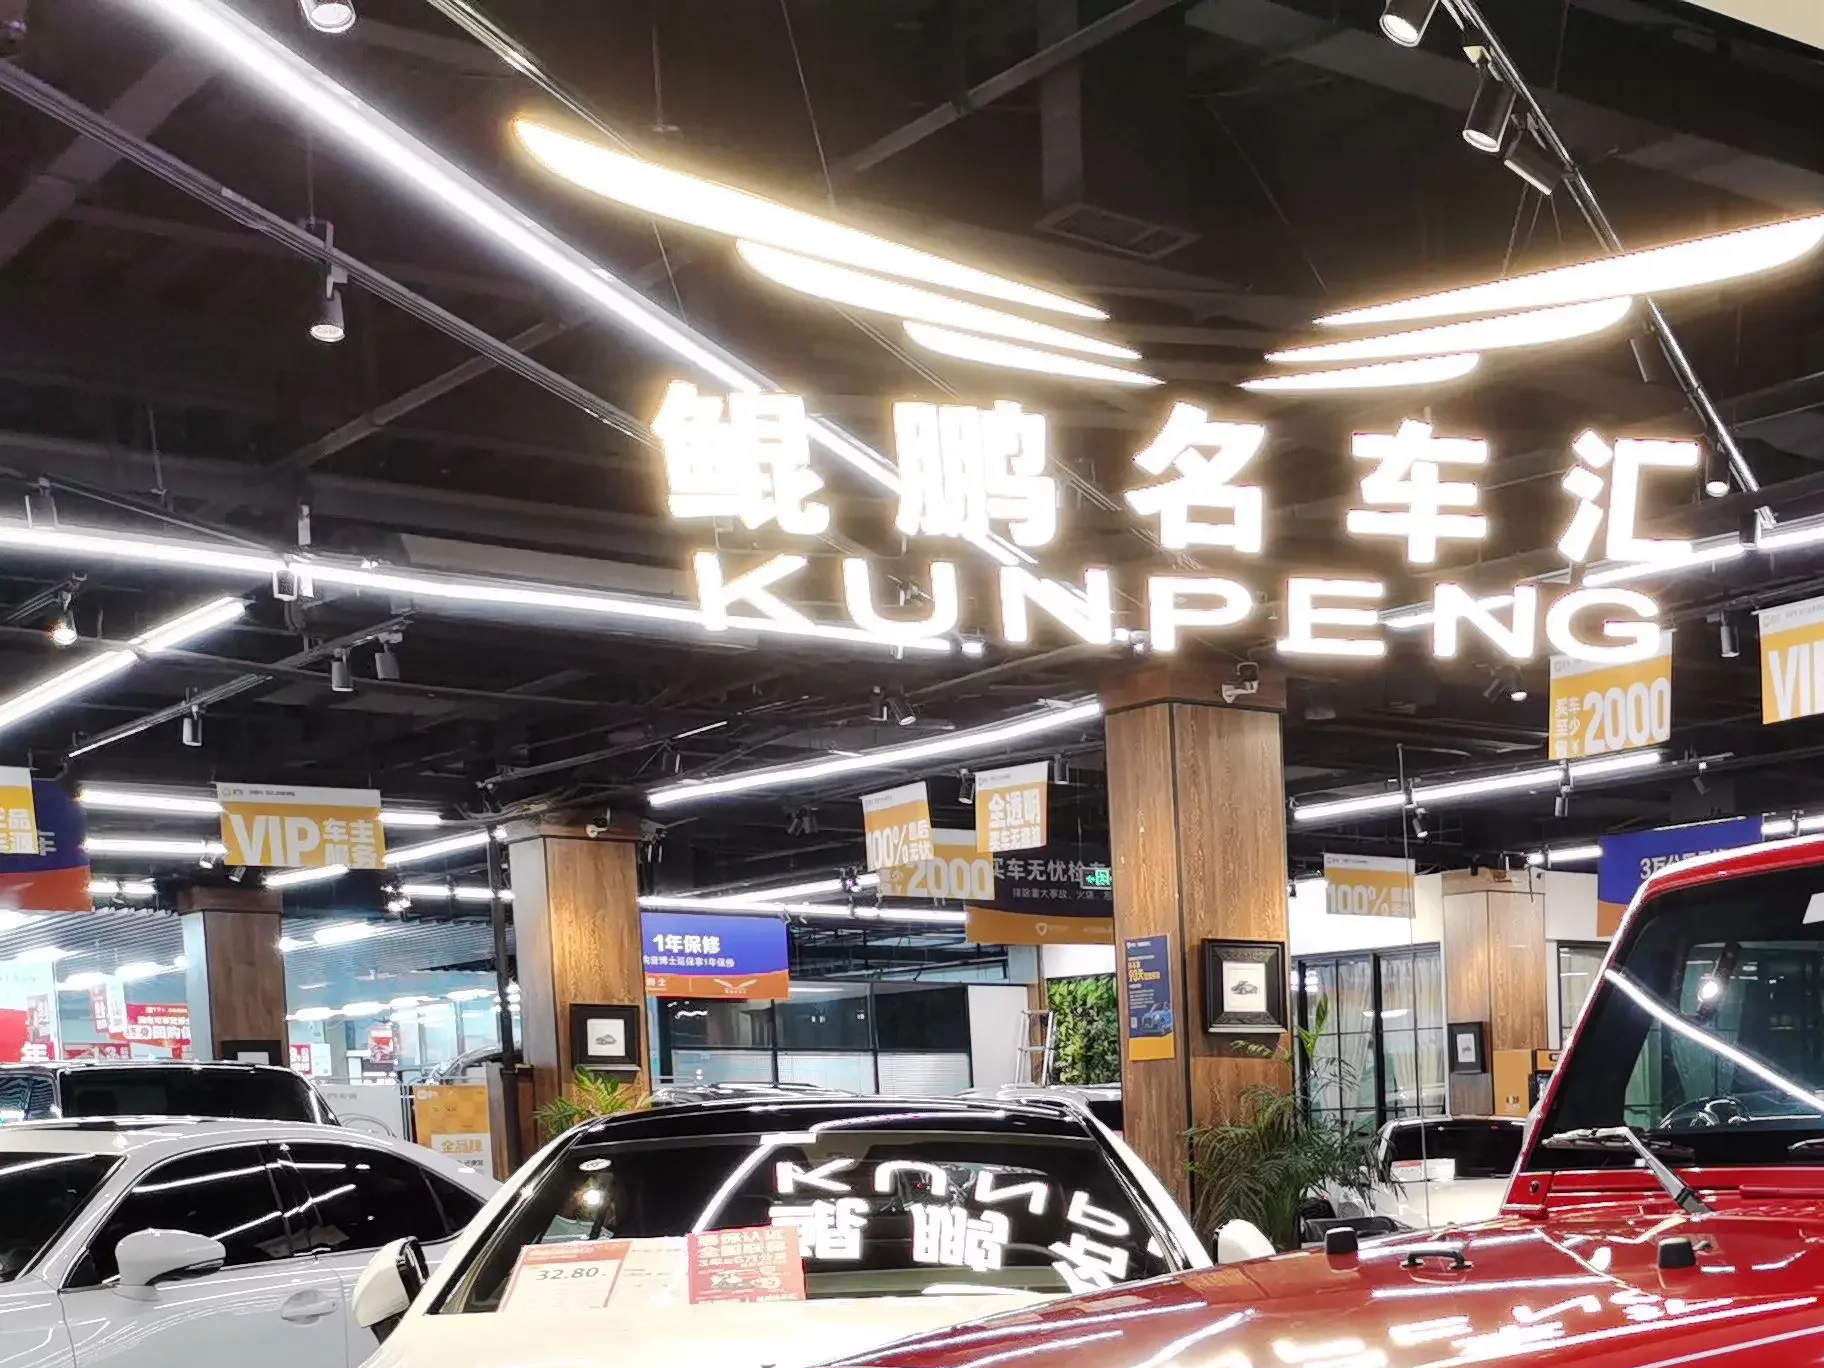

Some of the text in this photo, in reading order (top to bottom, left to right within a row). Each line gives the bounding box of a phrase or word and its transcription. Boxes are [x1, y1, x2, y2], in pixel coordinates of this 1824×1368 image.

[653, 379, 1702, 565] 鲲鹏名车汇
[693, 549, 1664, 660] KUNPENG
[1583, 677, 1670, 755] 2000
[230, 814, 320, 866] VIP
[867, 824, 909, 871] 100%
[907, 858, 991, 900] 2000
[652, 933, 721, 954] 1年保修
